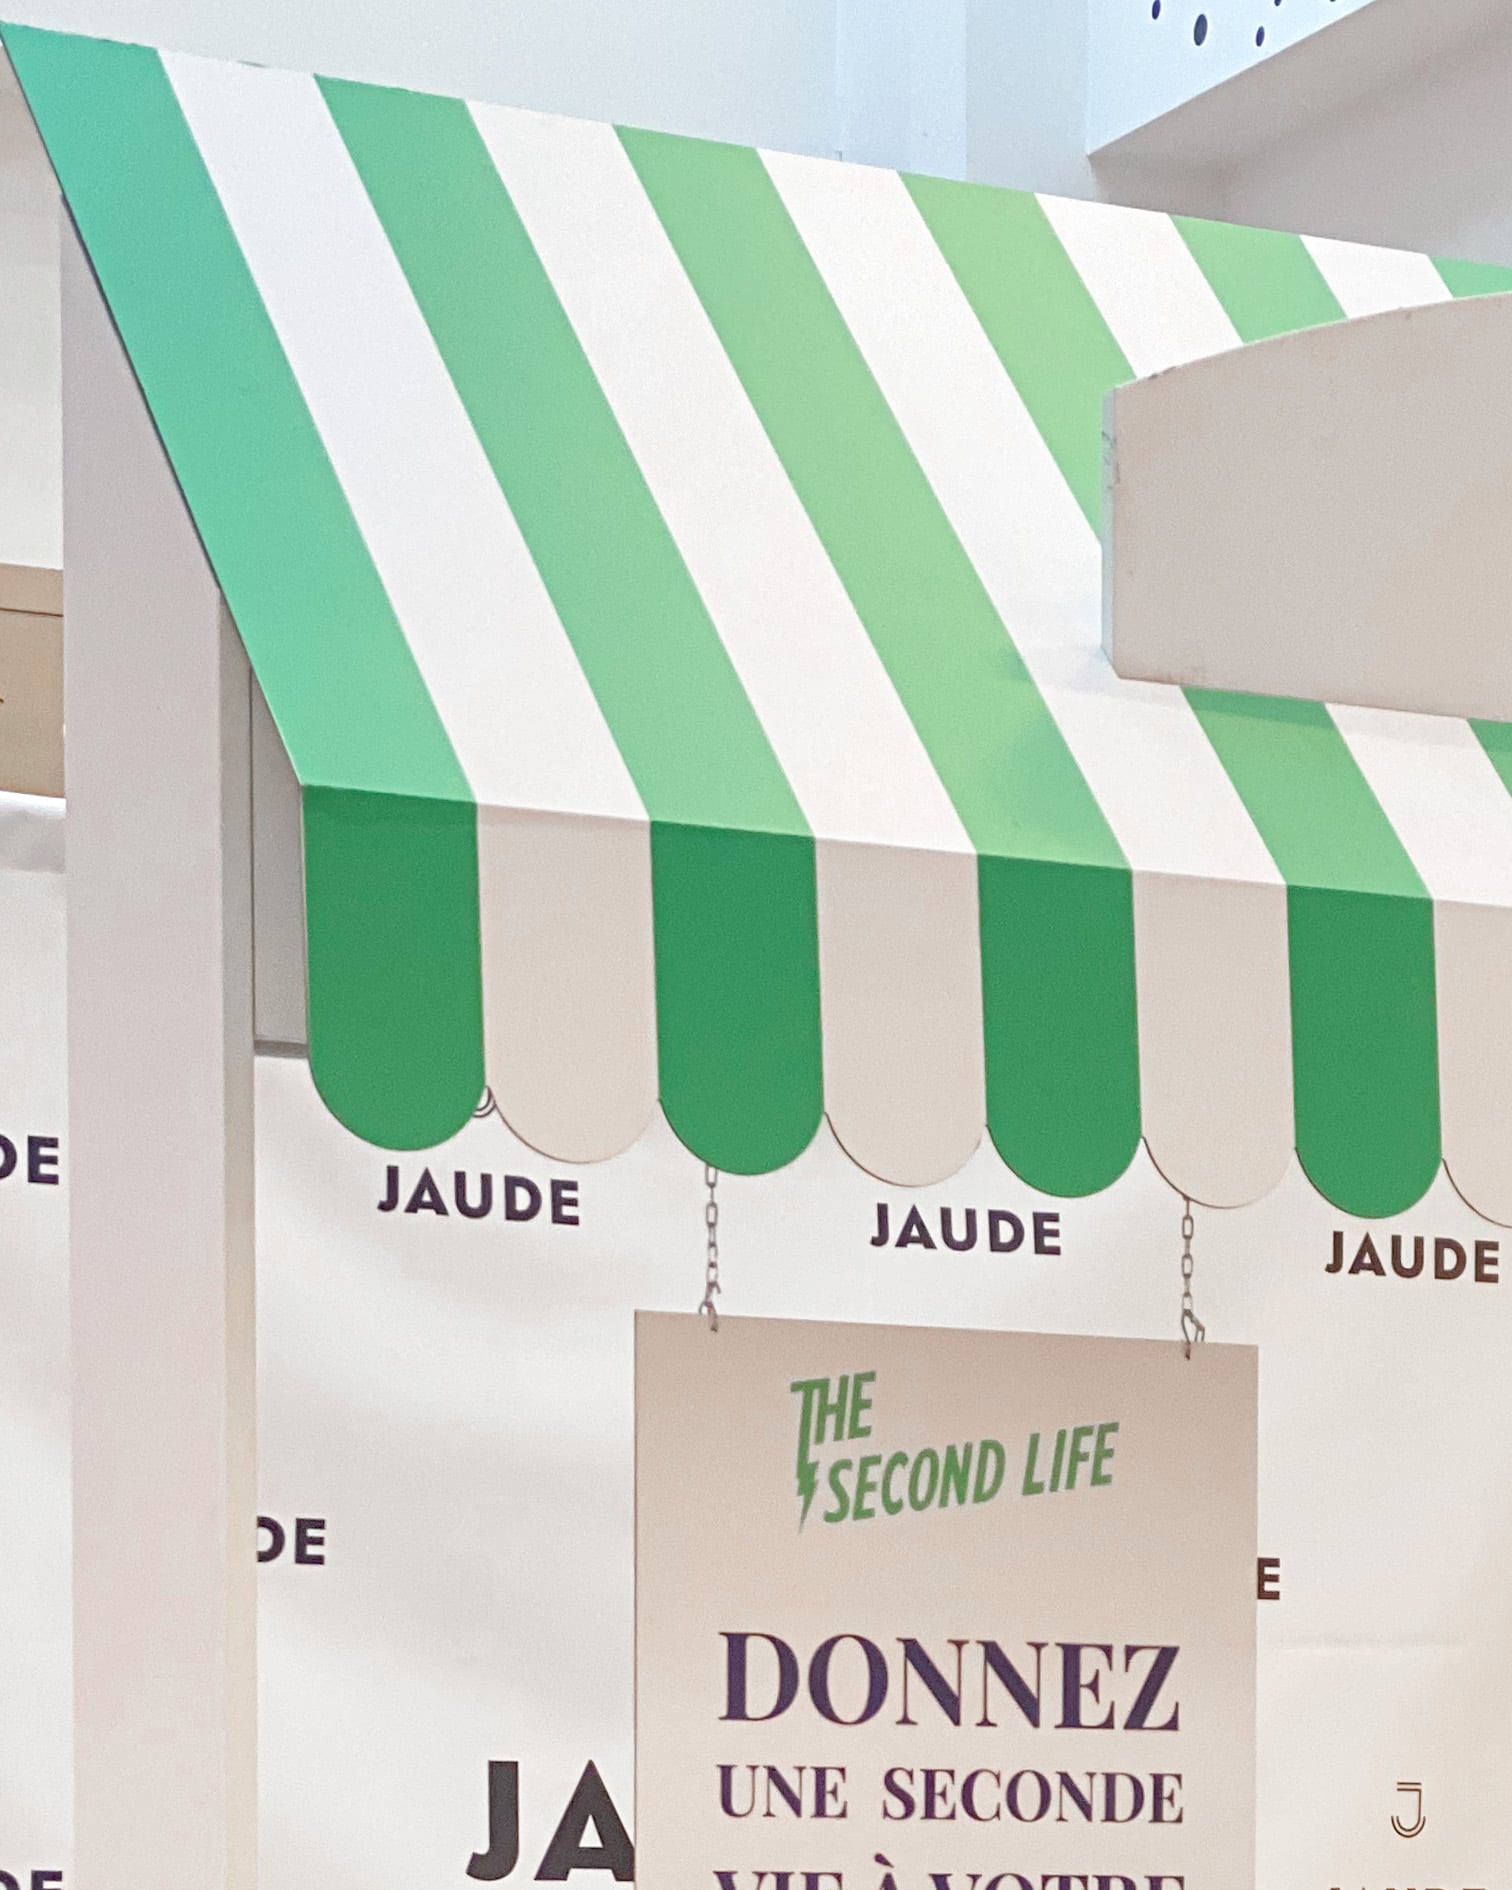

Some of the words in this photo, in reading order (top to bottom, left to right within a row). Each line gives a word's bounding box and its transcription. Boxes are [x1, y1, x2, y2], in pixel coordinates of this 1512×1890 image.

[377, 1165, 579, 1226] JAUDE
[870, 1203, 1061, 1255] JAUDE
[1325, 1231, 1499, 1283] JAUDE
[824, 1440, 1005, 1523] SECOND
[1022, 1422, 1119, 1496] LIFE
[719, 1632, 1179, 1731] DONNEZ
[717, 1765, 847, 1818] UNE
[883, 1768, 1183, 1823] SECONDE
